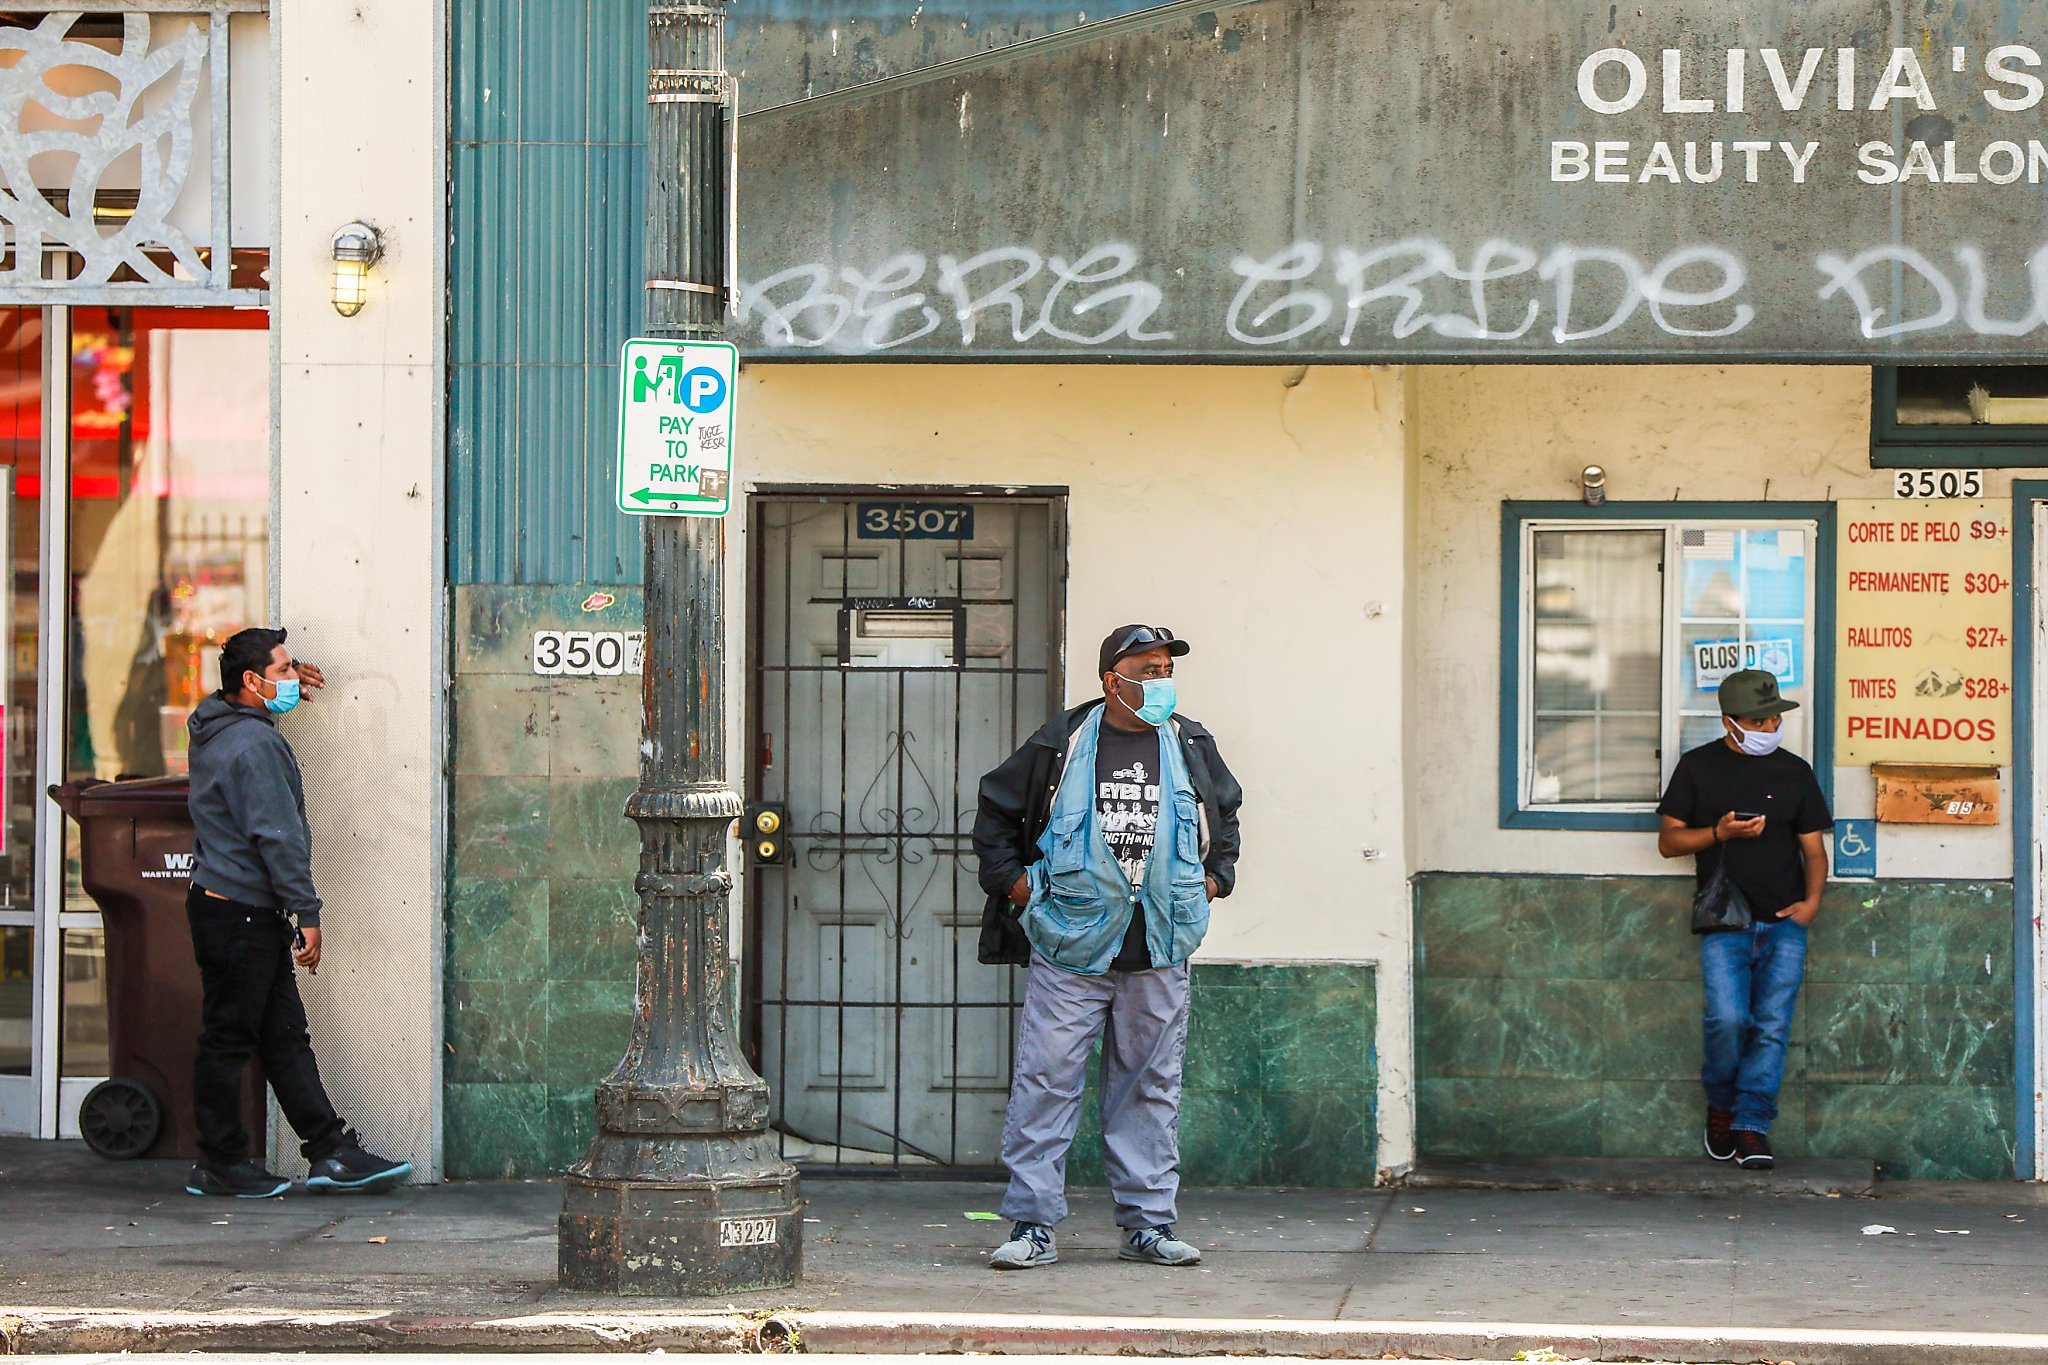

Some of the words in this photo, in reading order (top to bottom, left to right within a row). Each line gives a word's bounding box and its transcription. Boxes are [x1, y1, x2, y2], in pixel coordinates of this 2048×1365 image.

[1577, 45, 2045, 114] OLIVIA'S
[1551, 141, 1820, 183] BEAUTY
[690, 375, 719, 407] P
[659, 416, 695, 435] PAY
[665, 440, 687, 458] TO
[650, 464, 699, 482] PARK
[1898, 471, 1981, 498] 3505
[865, 509, 967, 532] 3507
[1848, 522, 1894, 543] CORTE
[1901, 522, 1918, 543] DE
[1925, 522, 1960, 543] PELO
[1970, 520, 2009, 540] $9+
[1849, 571, 1949, 593] PERMANENTE
[1964, 573, 2010, 594] $30+
[1848, 627, 1912, 648] RALLITOS
[1966, 627, 2007, 648] $27+
[1700, 645, 1755, 669] CLOSD
[1849, 679, 1896, 699] TINTES
[1965, 677, 2010, 699] $28+
[1847, 716, 1996, 742] PEINADOS
[1100, 782, 1141, 800] EYES
[721, 1220, 774, 1244] A3227
